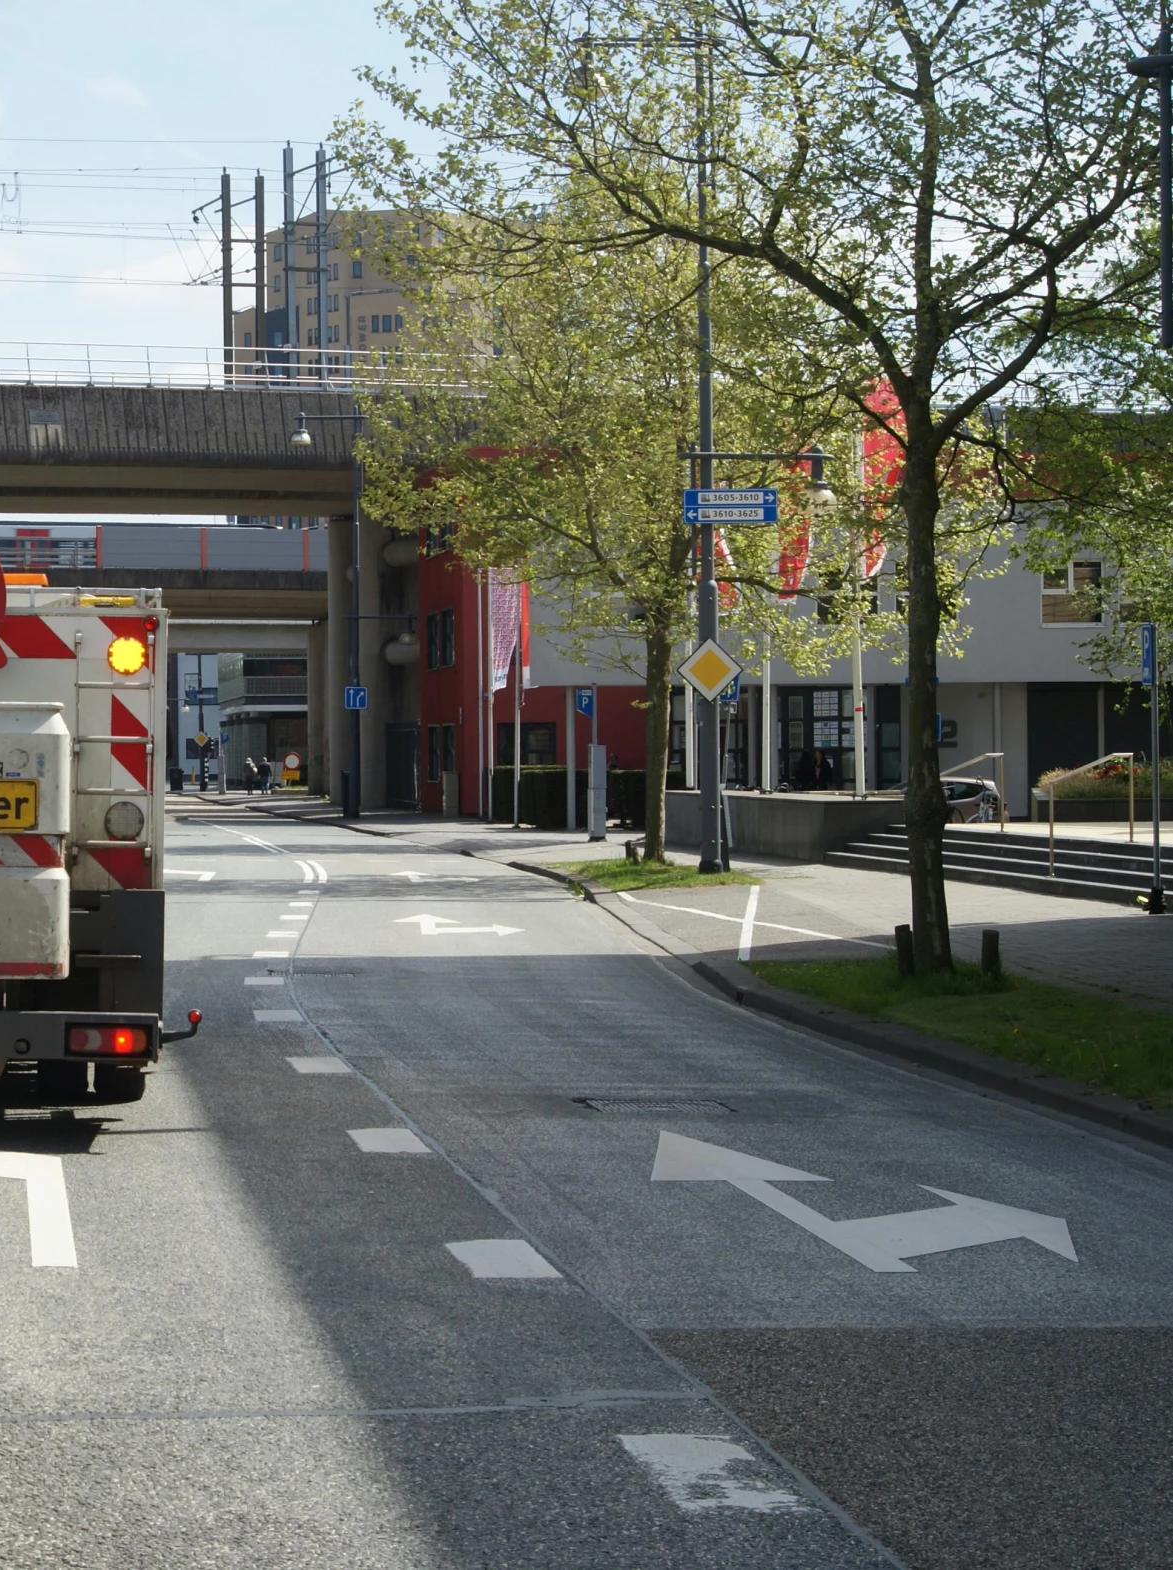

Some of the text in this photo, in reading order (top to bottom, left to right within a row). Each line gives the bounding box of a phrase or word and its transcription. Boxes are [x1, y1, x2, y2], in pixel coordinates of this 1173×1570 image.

[713, 493, 759, 501] 3605-3610
[713, 510, 759, 518] 3610-3625
[582, 696, 589, 708] P
